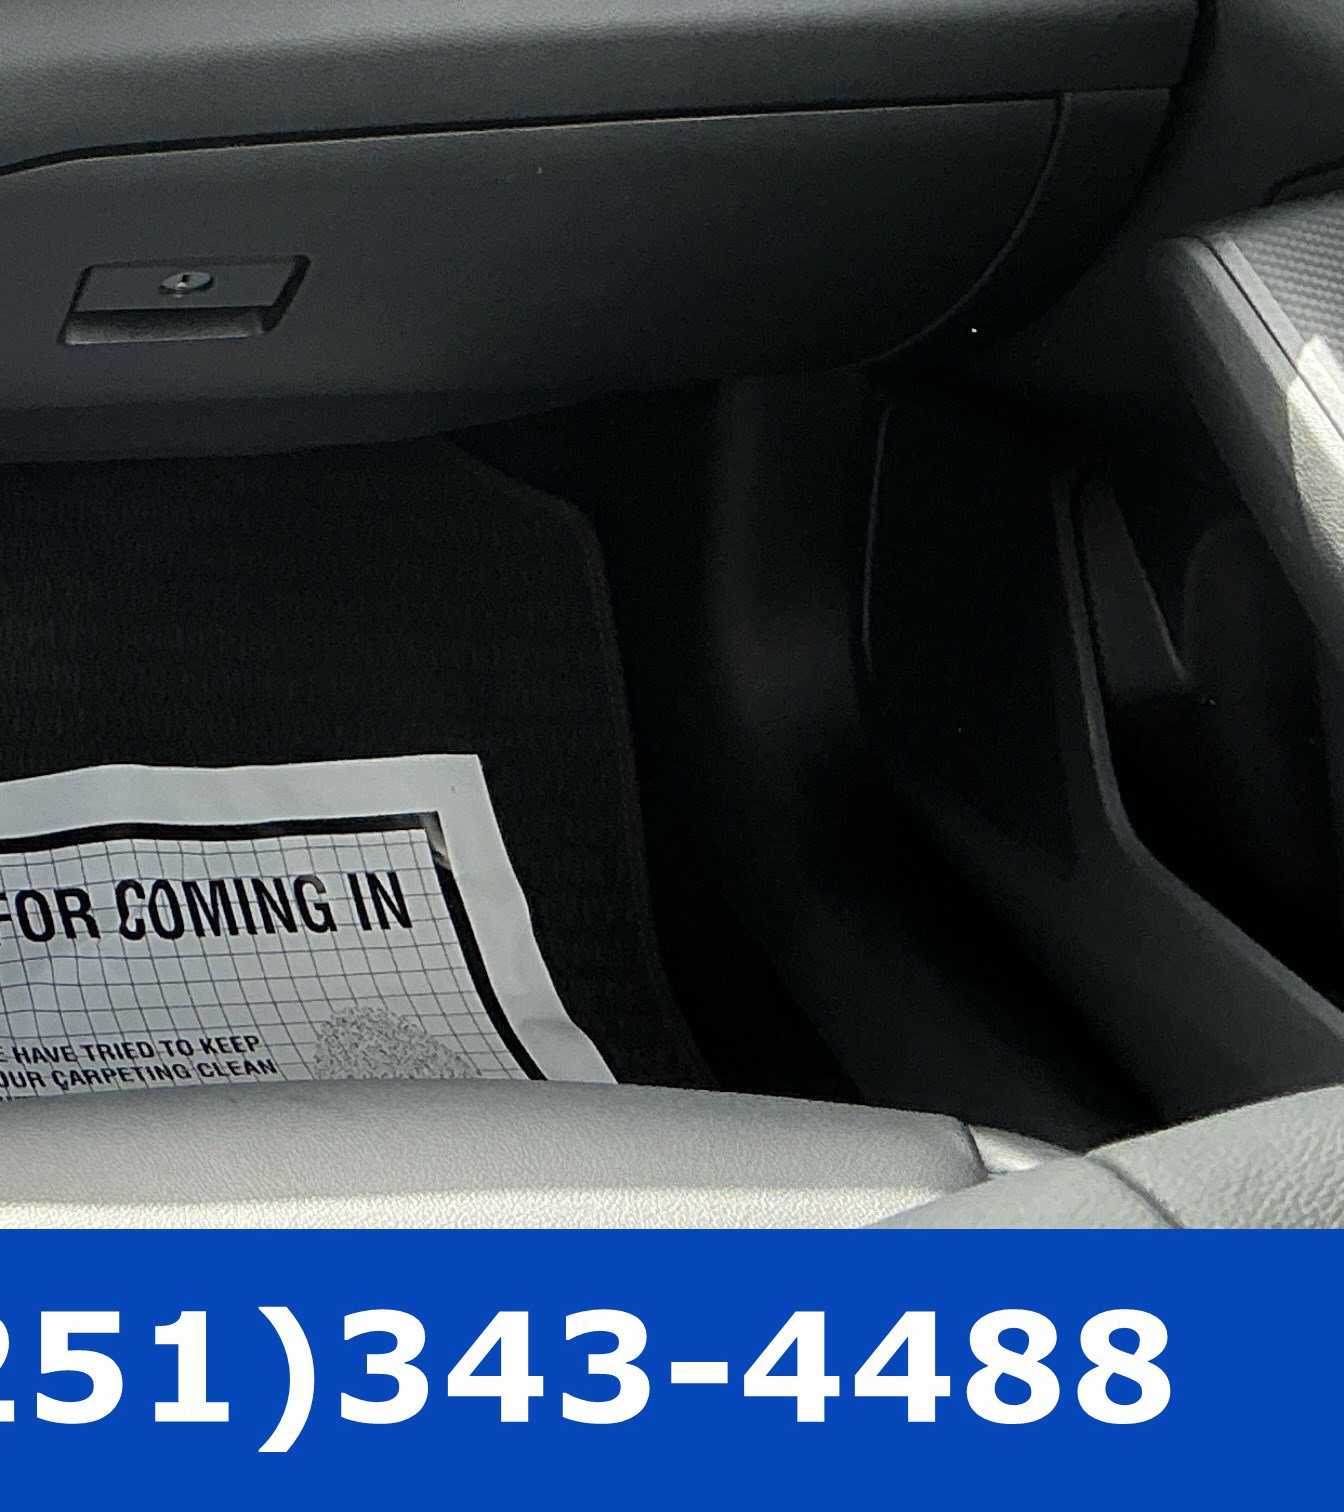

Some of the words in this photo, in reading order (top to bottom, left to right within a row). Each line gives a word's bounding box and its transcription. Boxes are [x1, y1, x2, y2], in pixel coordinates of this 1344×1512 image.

[113, 874, 338, 942] COMING
[347, 869, 413, 931] IN
[12, 1044, 78, 1065] HAVE
[80, 1040, 155, 1062] TRIED
[159, 1038, 195, 1058] TO
[199, 1035, 260, 1055] KEEP
[52, 1062, 193, 1089] CARPETING
[196, 1058, 278, 1079] CLEAN
